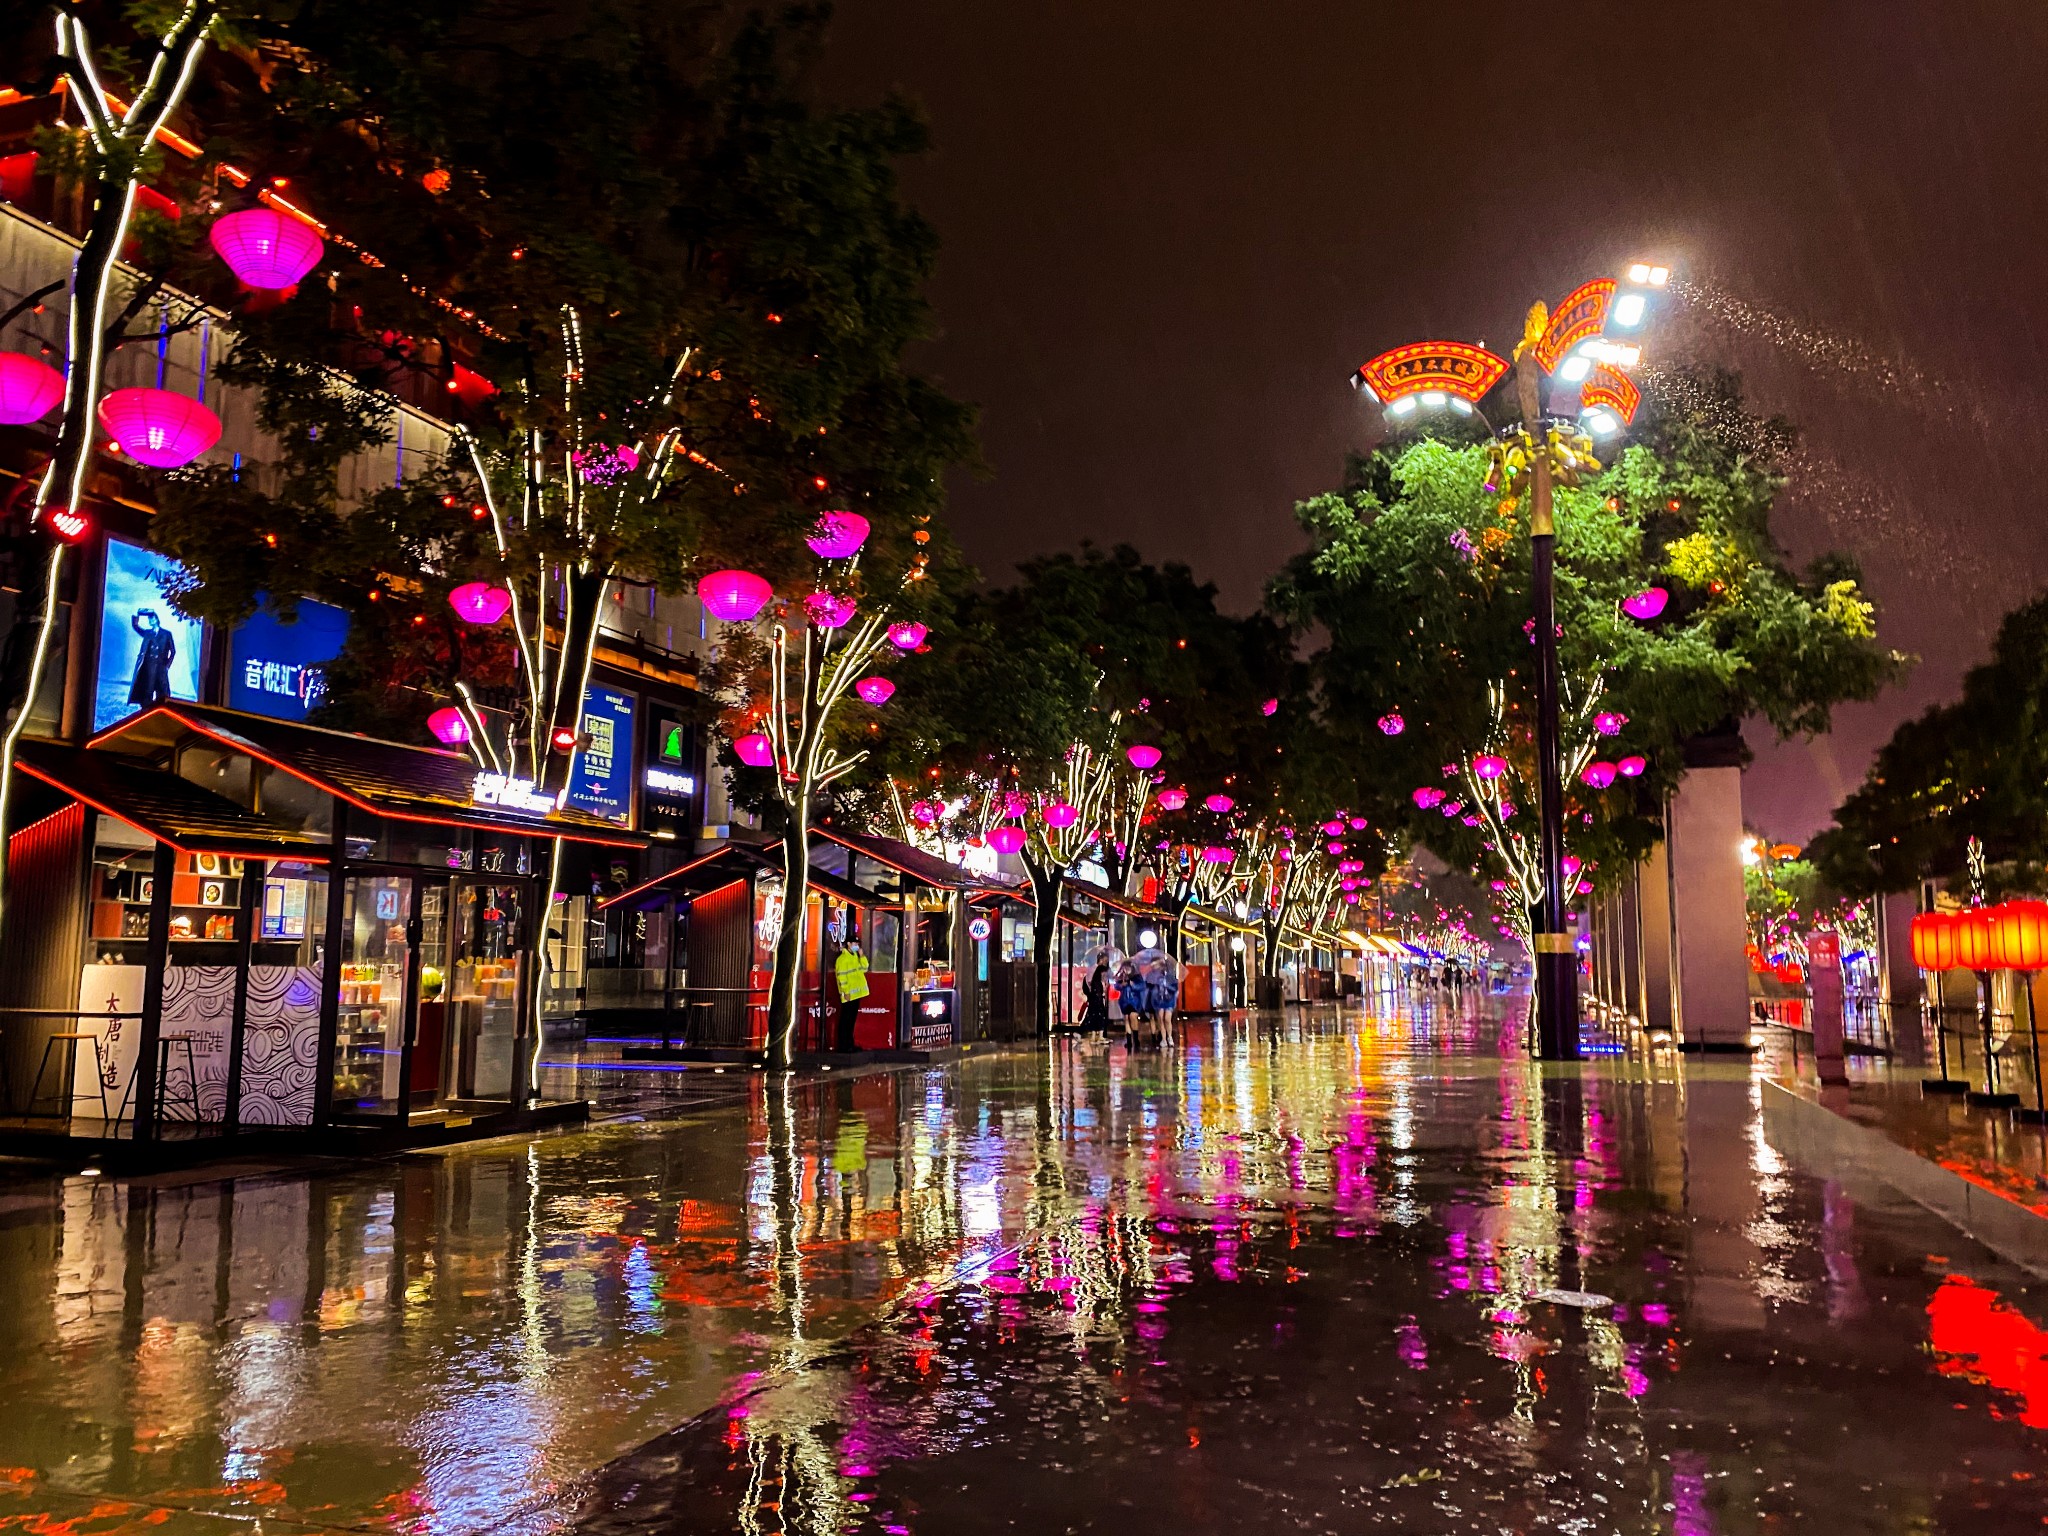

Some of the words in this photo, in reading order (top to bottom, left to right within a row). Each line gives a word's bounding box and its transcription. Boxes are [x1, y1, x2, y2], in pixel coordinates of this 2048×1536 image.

[245, 659, 297, 697] 音悦汇
[99, 992, 122, 1090] 大唐制造
